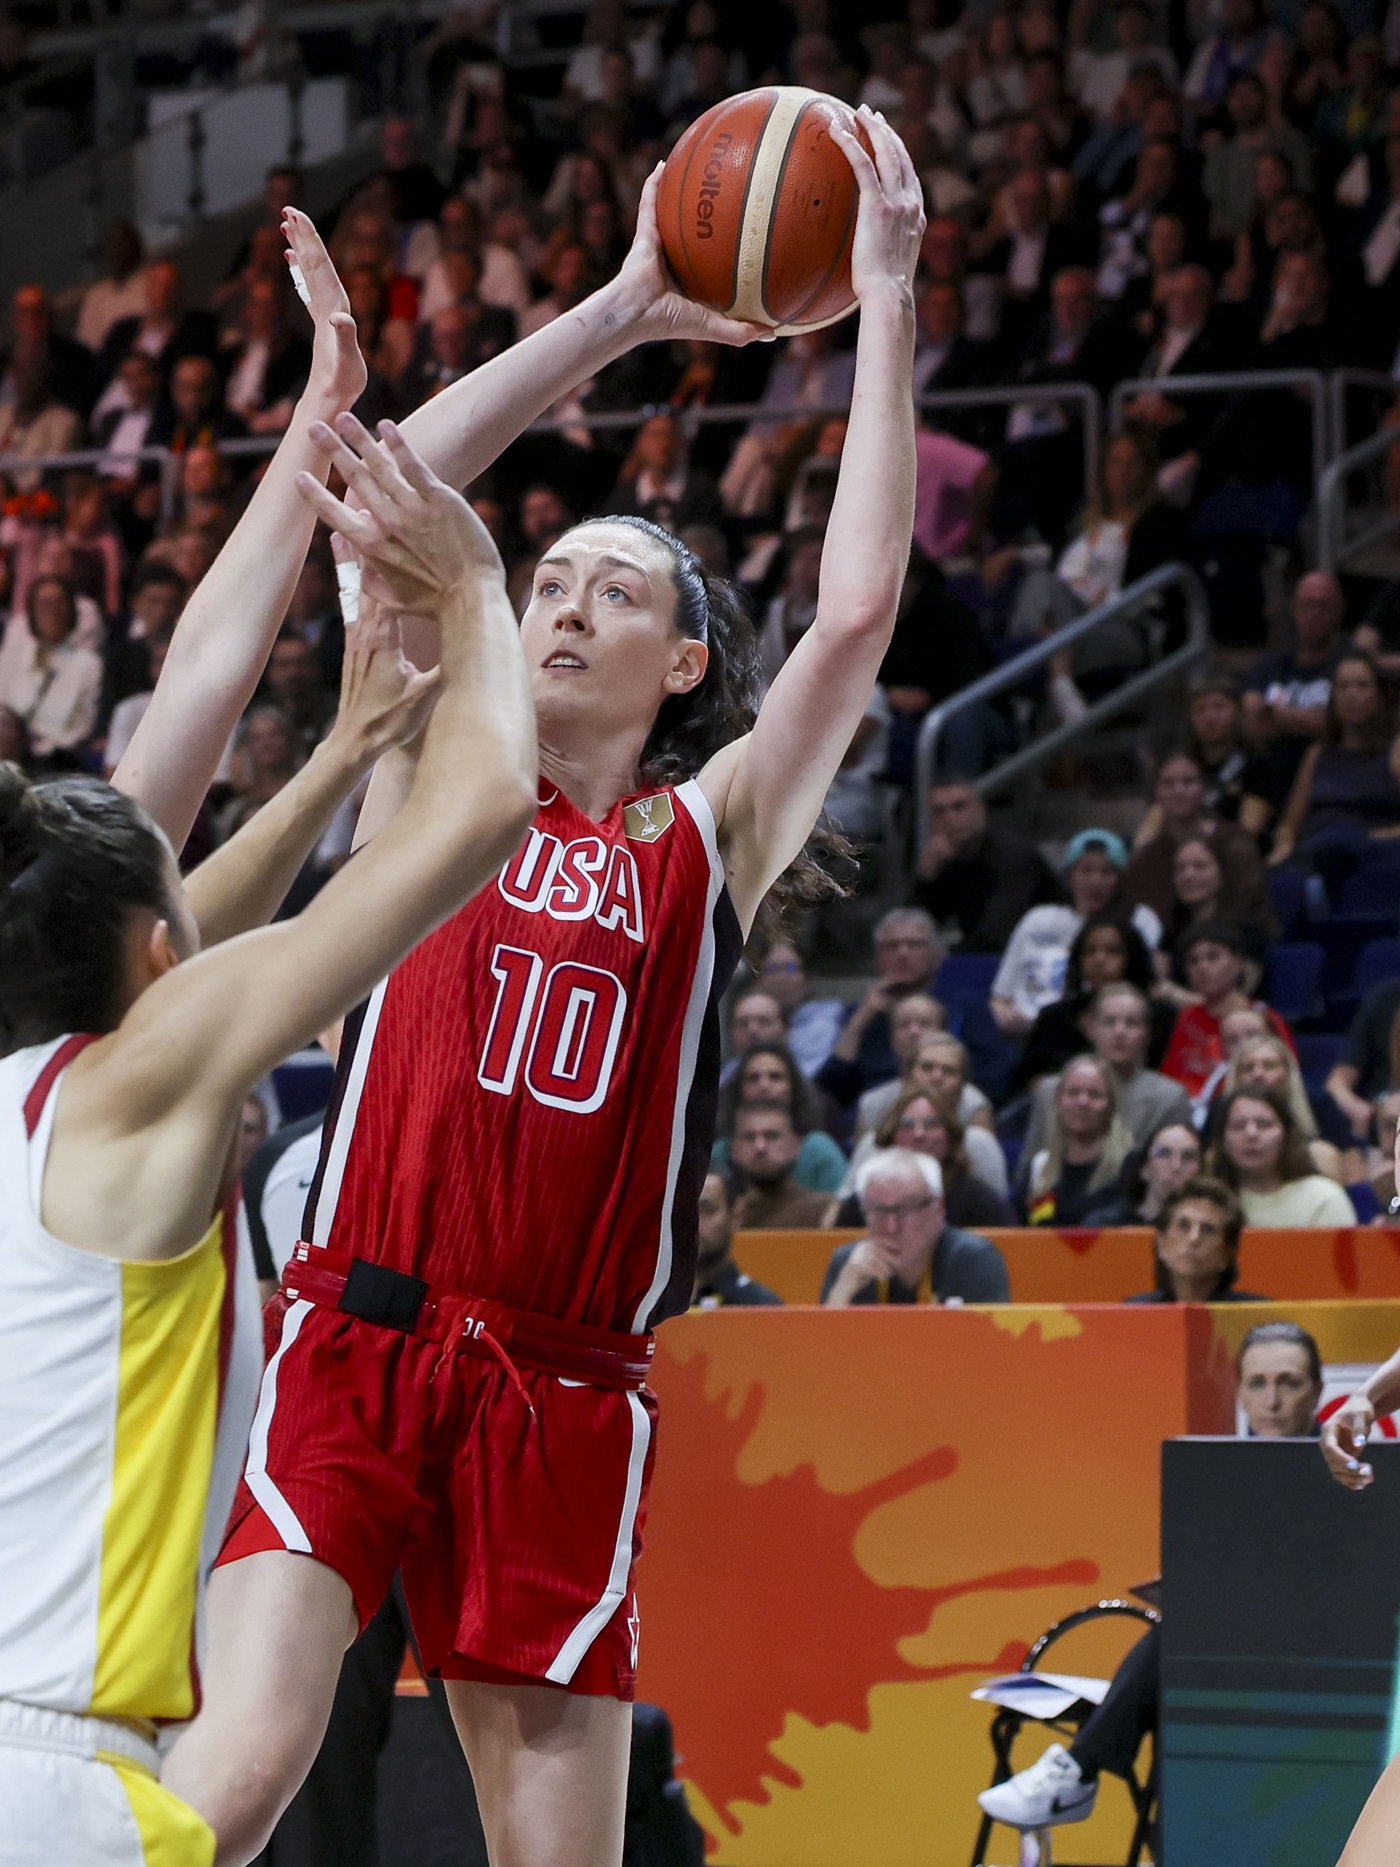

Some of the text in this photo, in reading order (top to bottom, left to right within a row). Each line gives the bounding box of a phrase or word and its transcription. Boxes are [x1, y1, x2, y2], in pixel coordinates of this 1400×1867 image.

[696, 132, 733, 239] molten
[498, 826, 645, 943] USA
[477, 943, 627, 1114] 10
